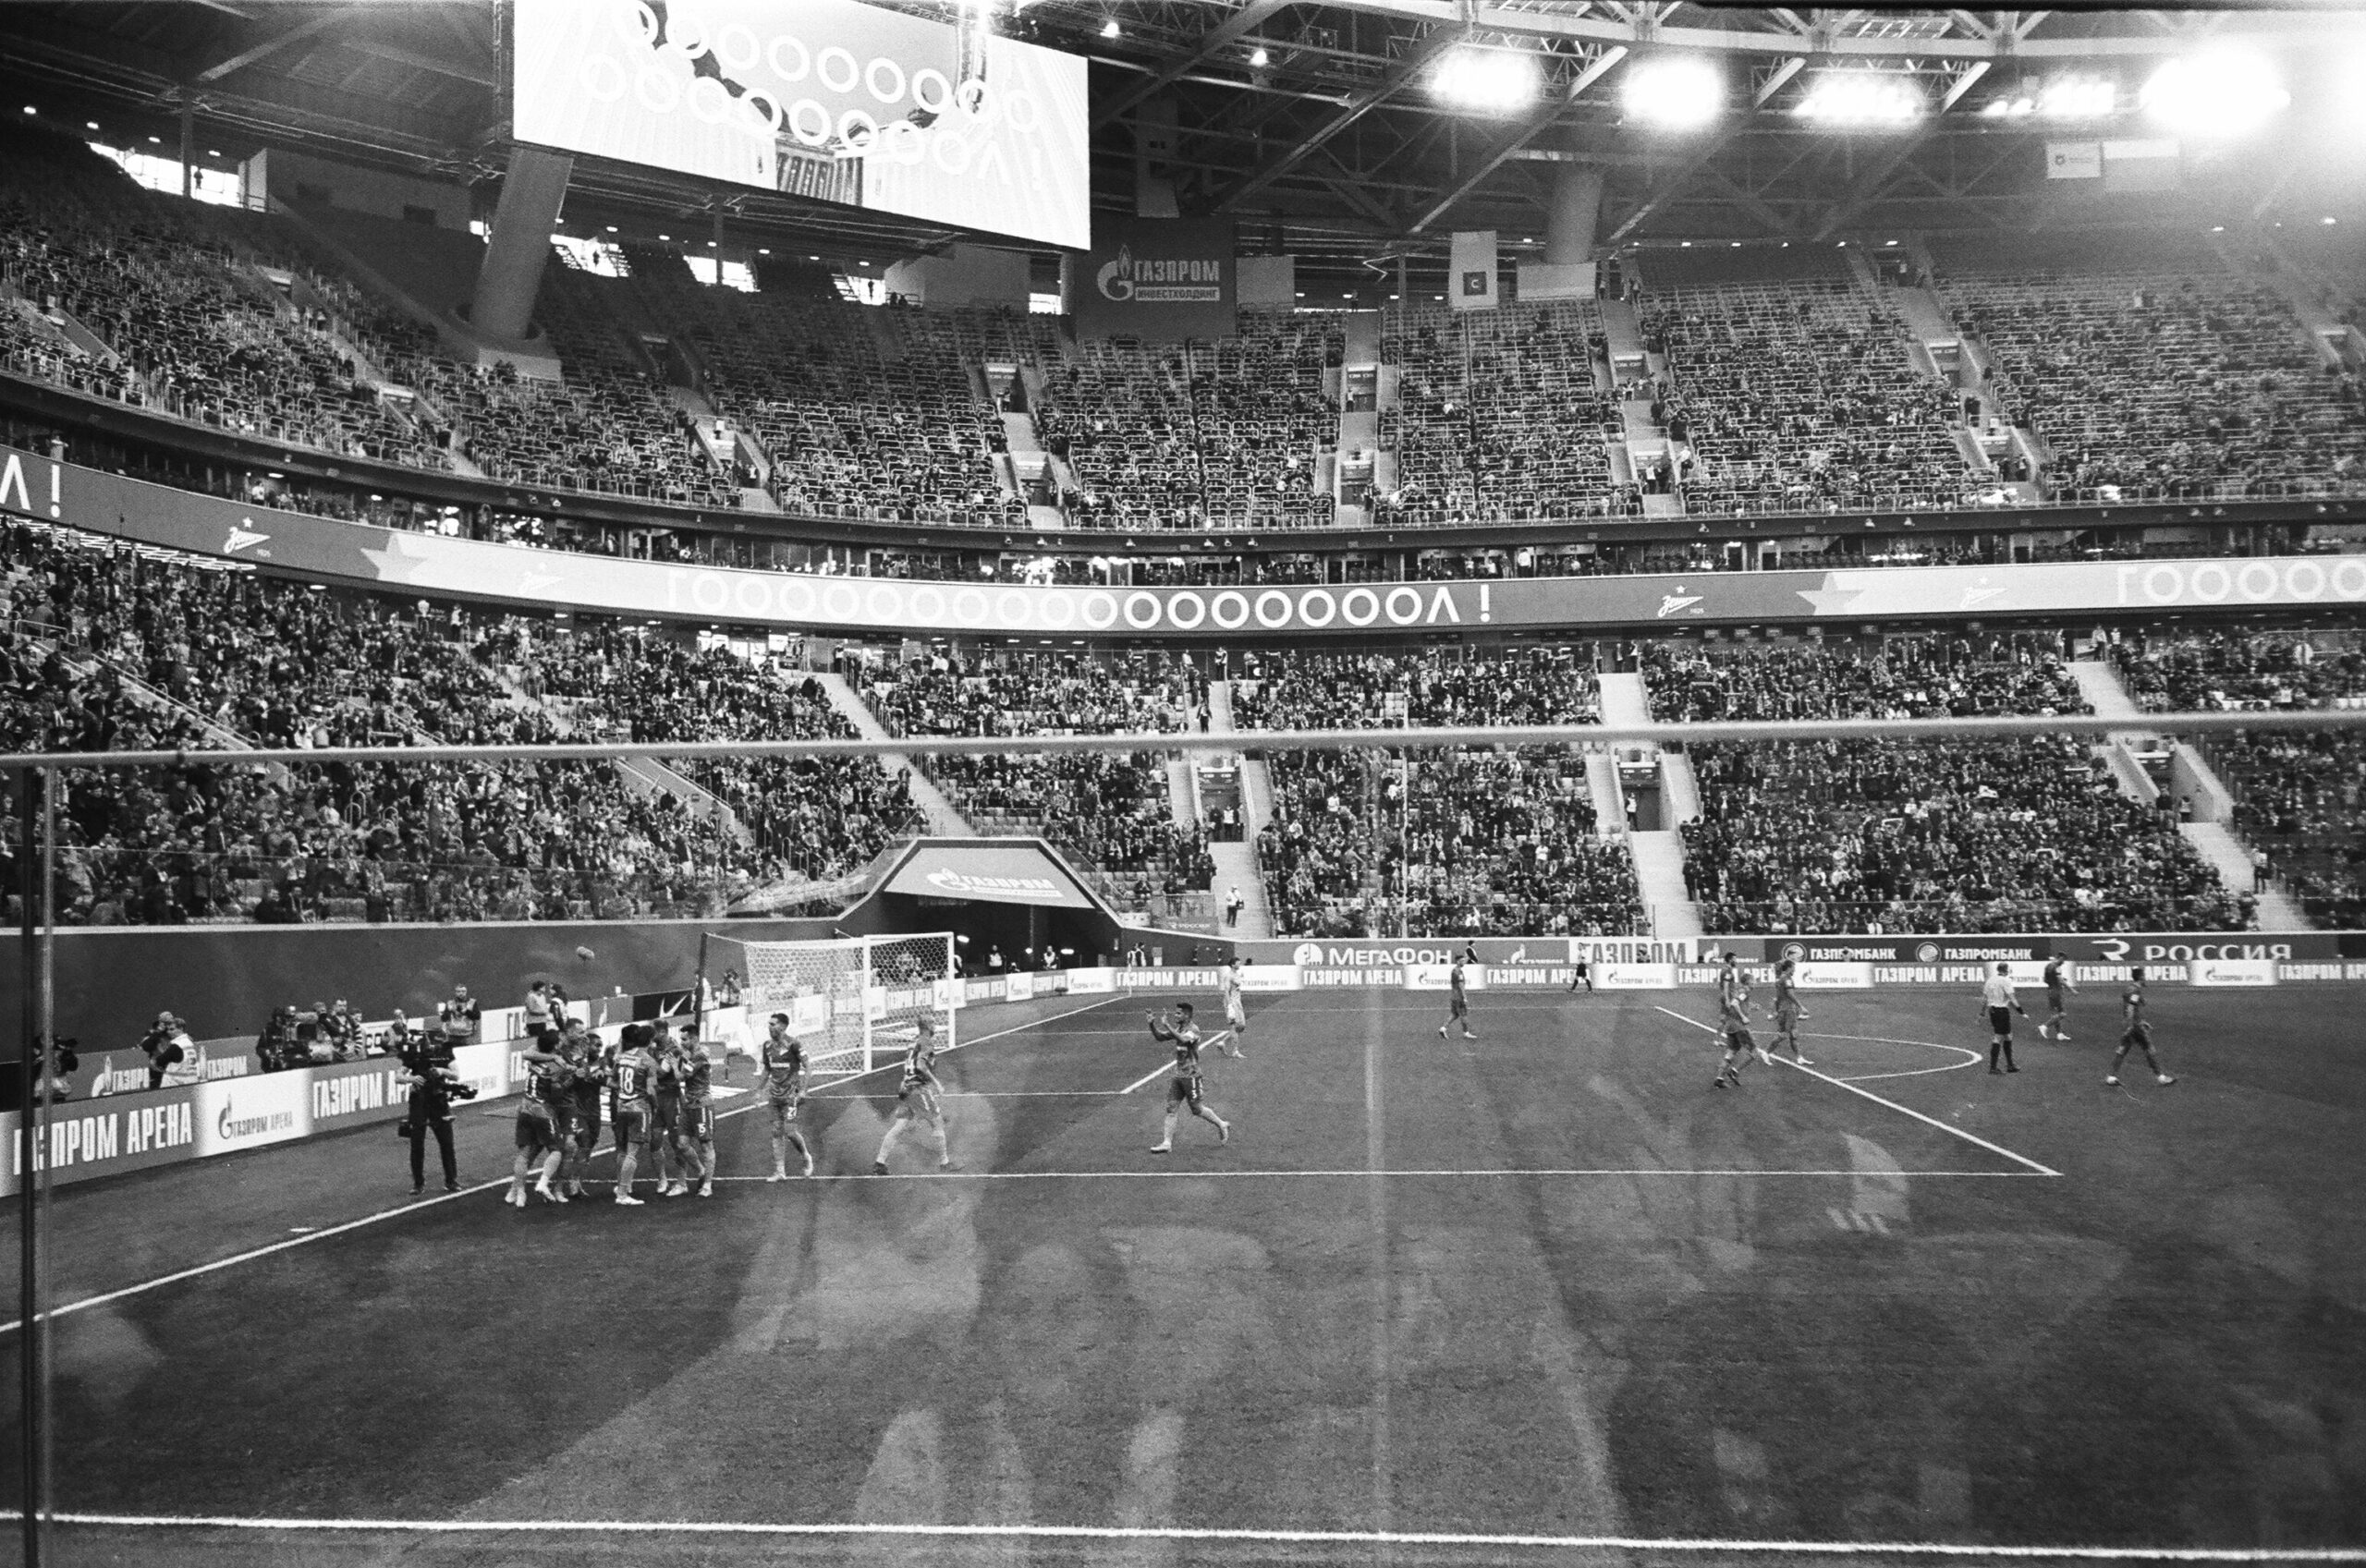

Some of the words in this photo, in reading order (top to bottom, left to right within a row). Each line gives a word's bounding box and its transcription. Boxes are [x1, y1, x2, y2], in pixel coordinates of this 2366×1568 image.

[1134, 260, 1220, 281] ГАЗПРОМ
[1138, 289, 1217, 299] ИНВЕСТХОЛДИНГ
[961, 875, 1055, 888] ГАЗПРОМ
[1945, 948, 2032, 960] ГАЗПРОМБАНК
[2144, 943, 2292, 961] РОССИЯ
[1116, 971, 1174, 986] ГАЗПРОМ
[1178, 971, 1218, 986] АРЕНА
[1303, 970, 1362, 985] ГАЗПРОМ
[1365, 969, 1403, 985] АРЕНА
[1487, 968, 1546, 984] ГАЗПРОМ
[1874, 967, 1937, 982] ГАЗПРОМ
[1942, 967, 1985, 982] АРЕНА
[2144, 966, 2189, 981] АРЕНА
[2279, 964, 2342, 979] ГАЗПРОМ
[618, 1067, 634, 1094] 18
[312, 1072, 383, 1119] ГАЗПРОМ
[127, 1102, 192, 1154] АРЕНА
